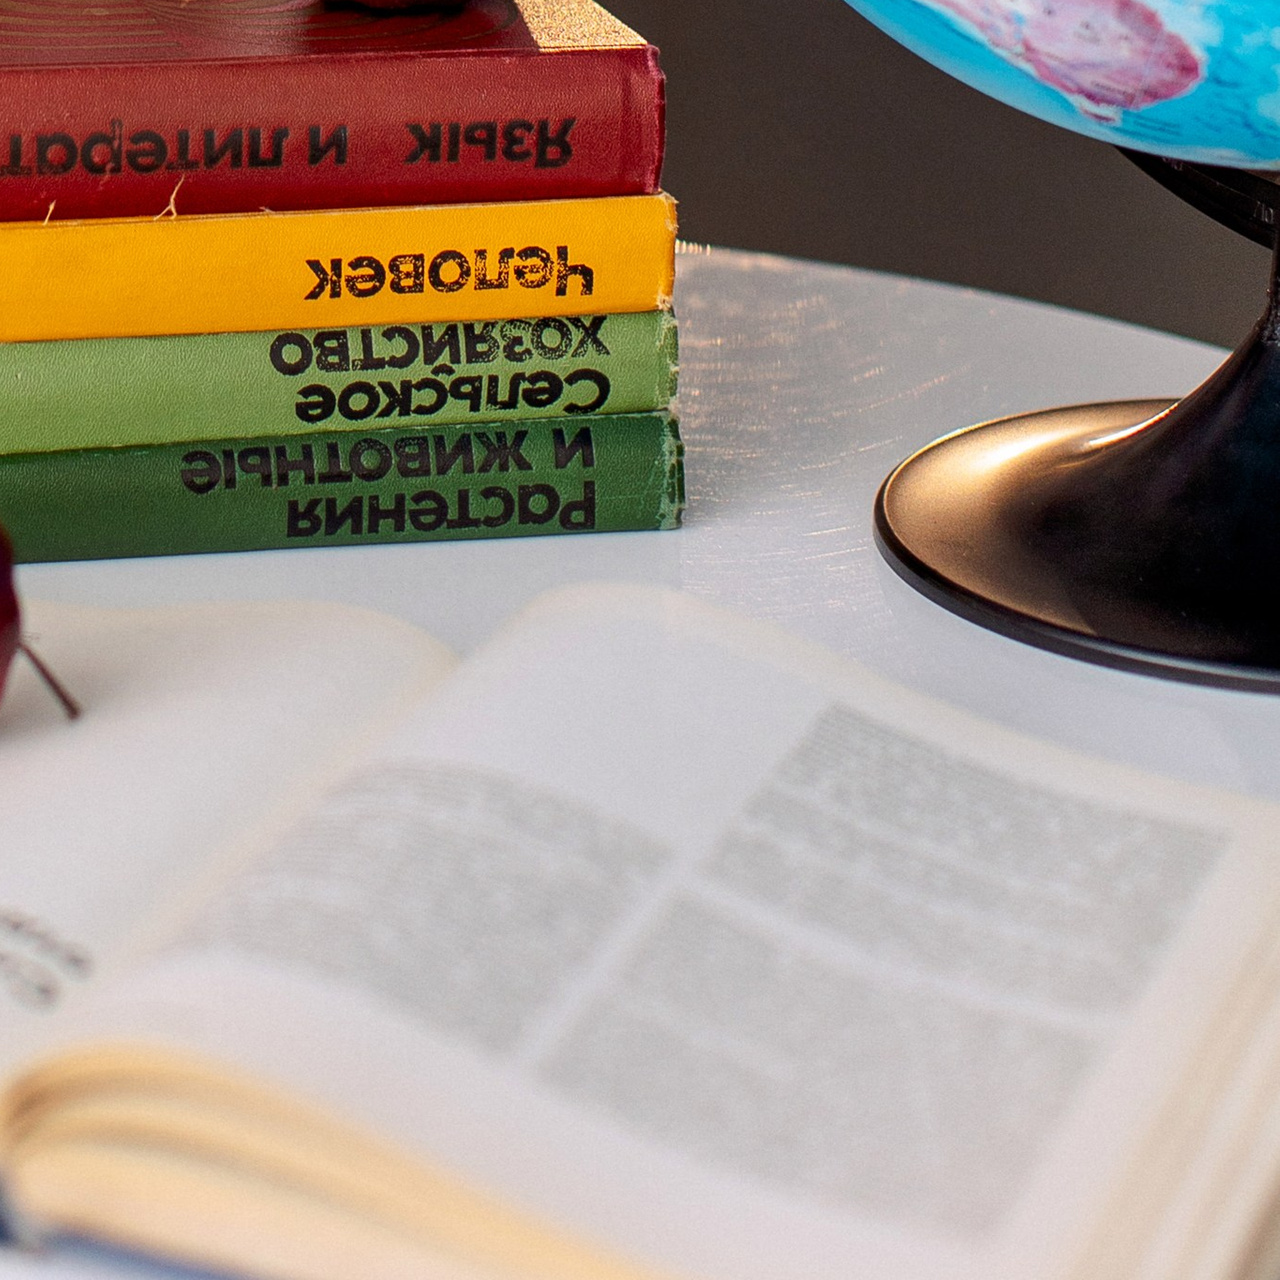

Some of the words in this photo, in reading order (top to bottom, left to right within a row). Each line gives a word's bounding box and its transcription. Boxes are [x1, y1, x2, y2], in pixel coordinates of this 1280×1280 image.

[308, 124, 349, 168] и
[404, 117, 576, 170] Язык
[304, 244, 595, 301] Человек
[269, 314, 612, 377] хозяйство
[295, 366, 612, 424] Сельское
[180, 430, 533, 495] животные
[552, 426, 596, 469] и
[286, 480, 596, 538] Растения
